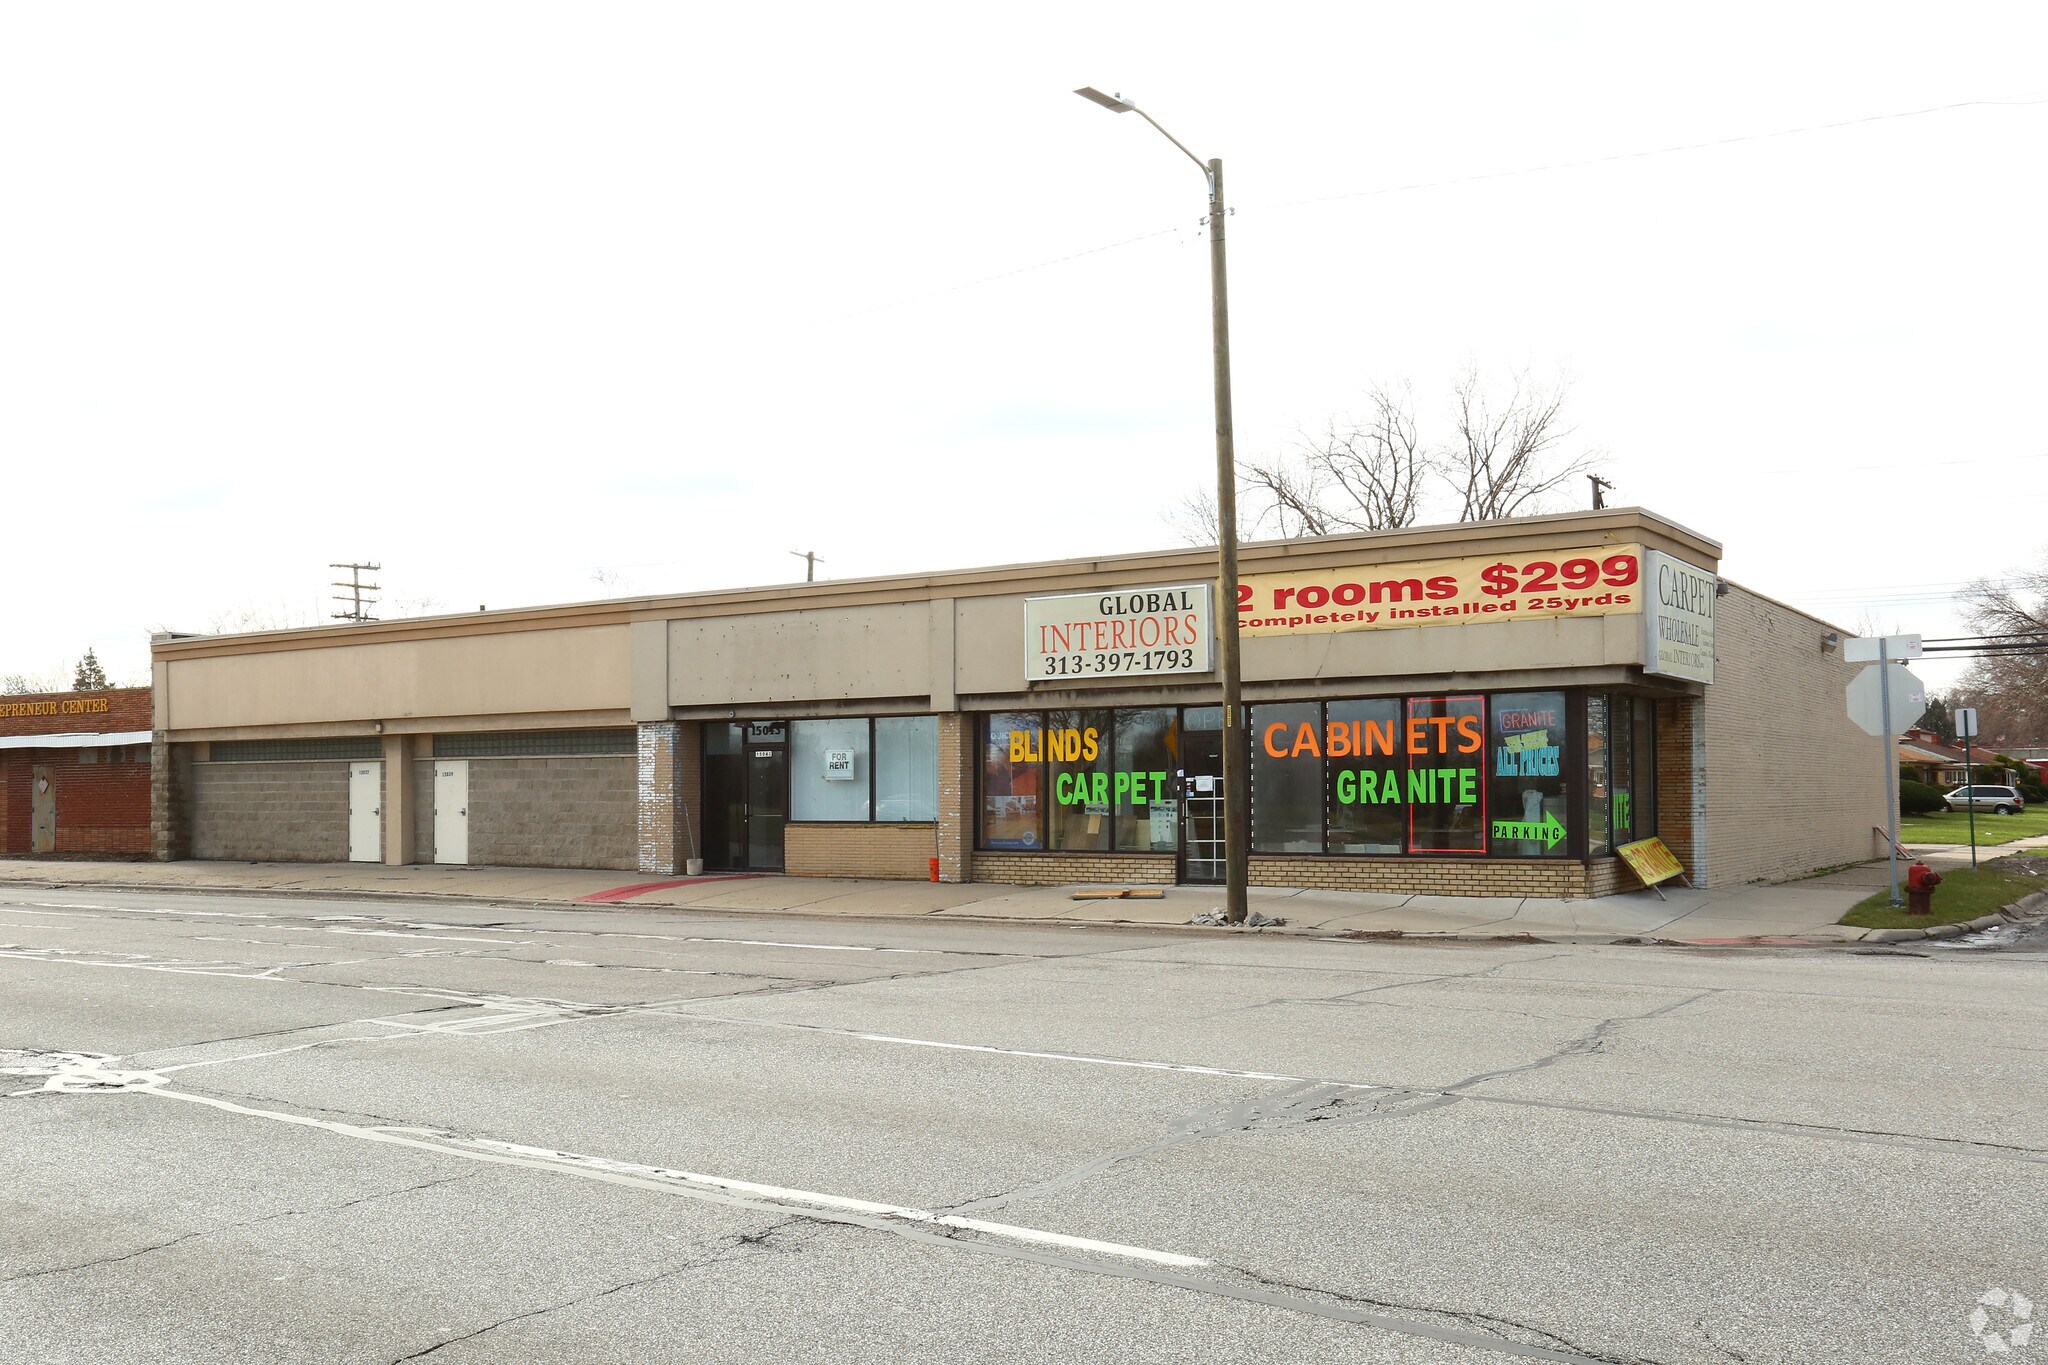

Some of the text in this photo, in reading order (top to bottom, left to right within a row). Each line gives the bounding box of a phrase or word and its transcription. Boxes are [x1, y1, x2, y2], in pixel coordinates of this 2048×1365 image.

[1274, 575, 1459, 610] rooms
[1481, 555, 1639, 598] $299
[1659, 564, 1714, 618] CARPET
[1099, 591, 1193, 615] GLOBAL
[1238, 593, 1631, 628] completely installed 25yrds
[1040, 614, 1197, 653] INTERIORS
[1658, 615, 1699, 647] WHOLESALE
[1045, 649, 1193, 675] 313-397-1793
[62, 699, 108, 713] CENTER
[1502, 710, 1557, 729] GRANITE
[1009, 727, 1099, 763] BLINDS
[1264, 715, 1482, 758] CABINETS
[829, 762, 849, 770] RENT
[832, 753, 847, 761] FOR
[1496, 746, 1560, 776] ALL PRICES
[1056, 771, 1167, 806] CARPET
[1337, 768, 1477, 804] GRANITE
[1493, 825, 1560, 840] PARKING
